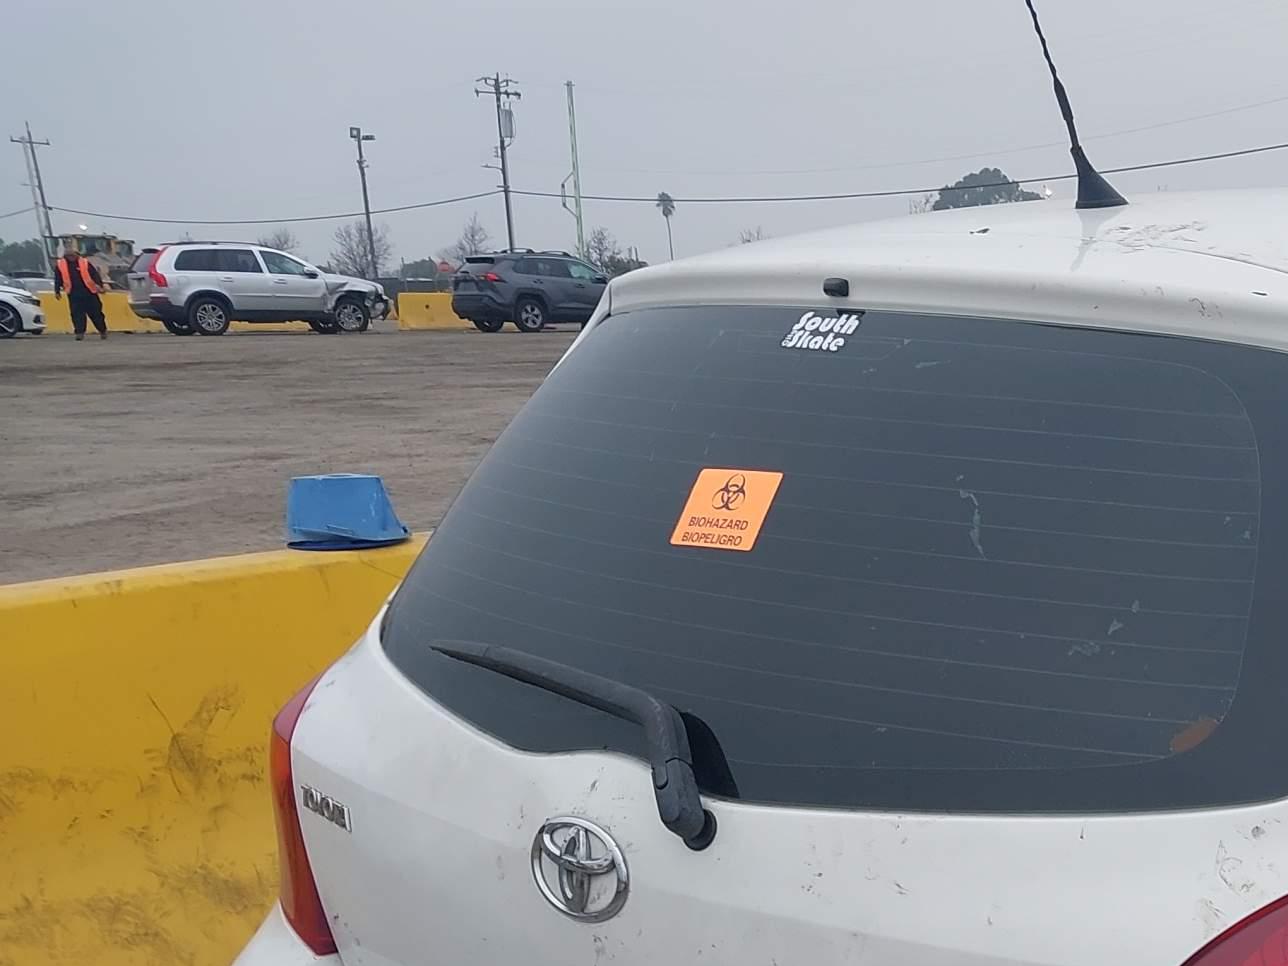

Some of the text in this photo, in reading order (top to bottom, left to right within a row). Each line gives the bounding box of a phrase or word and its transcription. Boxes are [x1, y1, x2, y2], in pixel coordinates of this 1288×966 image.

[791, 311, 860, 335] South
[786, 330, 845, 351] Skate
[688, 516, 749, 531] BIOHAZARD
[681, 532, 743, 546] BIOPELIGRO
